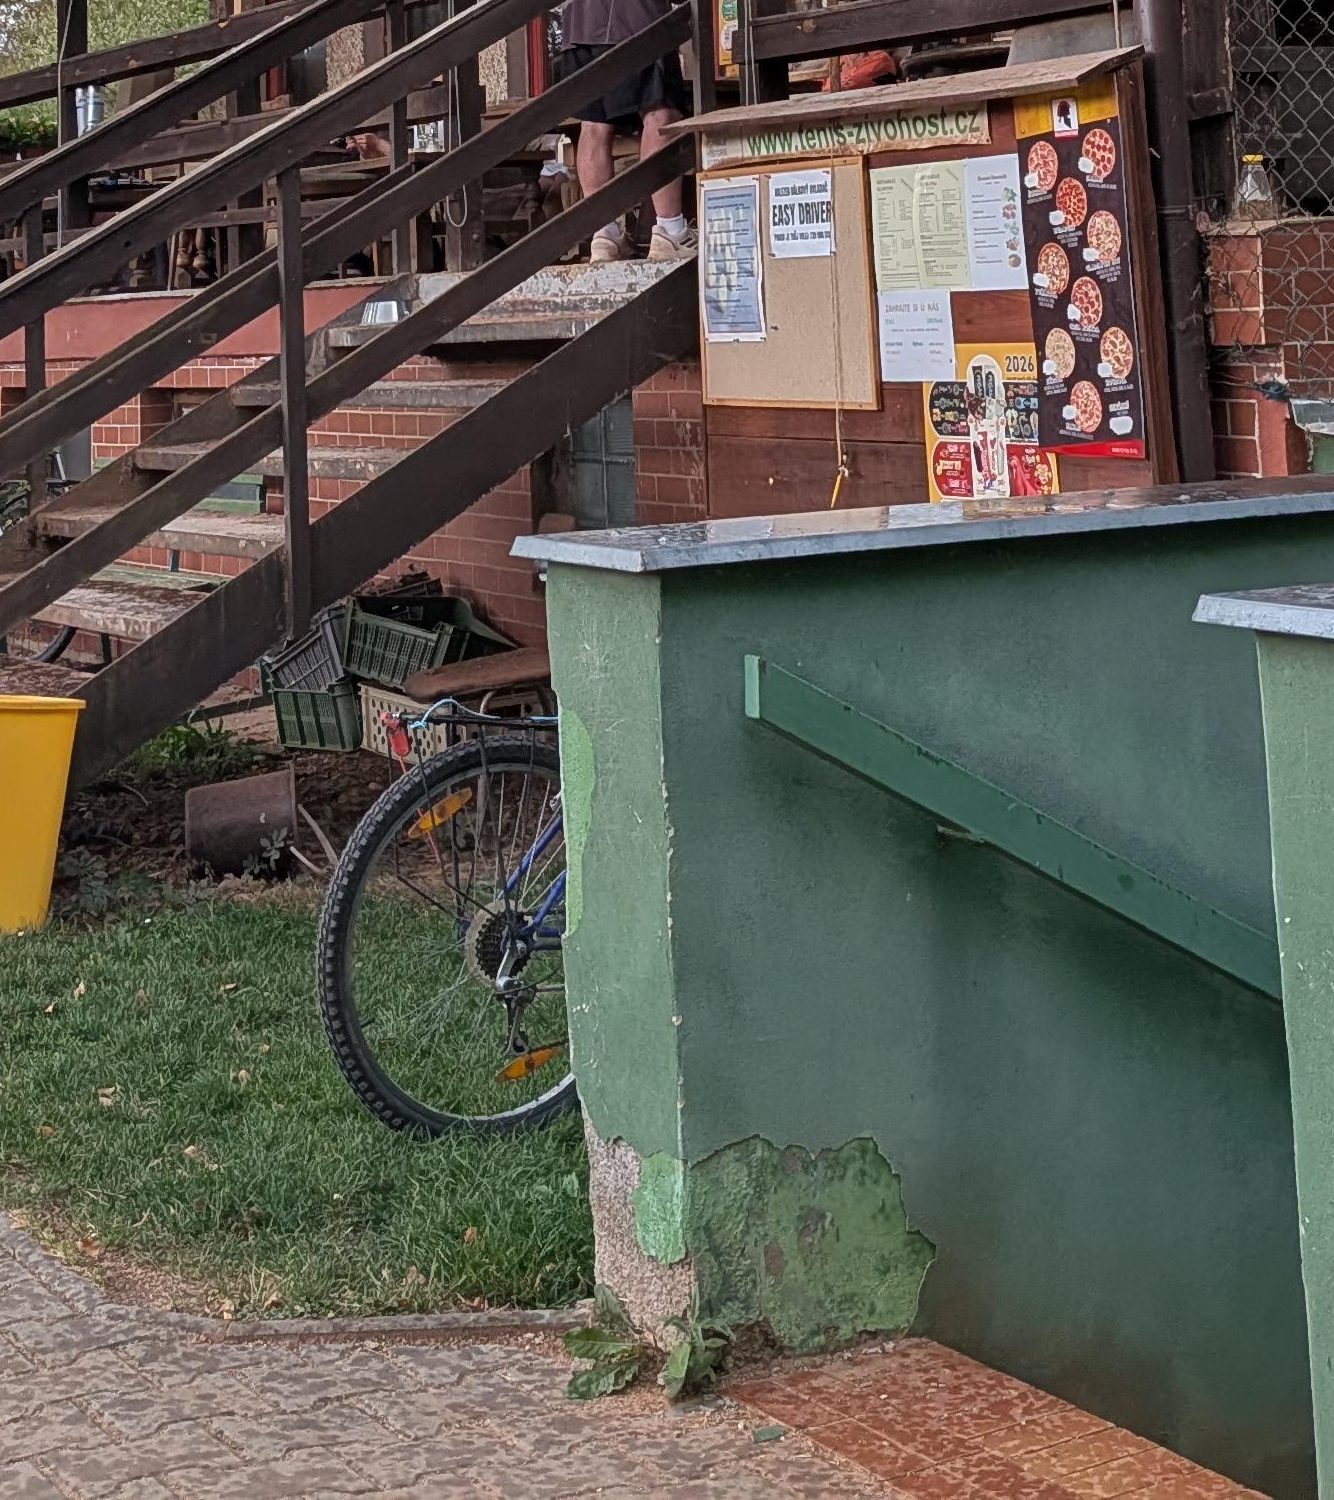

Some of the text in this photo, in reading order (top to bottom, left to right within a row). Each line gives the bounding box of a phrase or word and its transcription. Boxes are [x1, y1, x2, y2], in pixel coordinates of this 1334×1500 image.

[746, 106, 981, 156] www.tenis-zivohost.cz
[772, 200, 831, 227] EASY DRIVER
[1004, 355, 1035, 373] 2026
